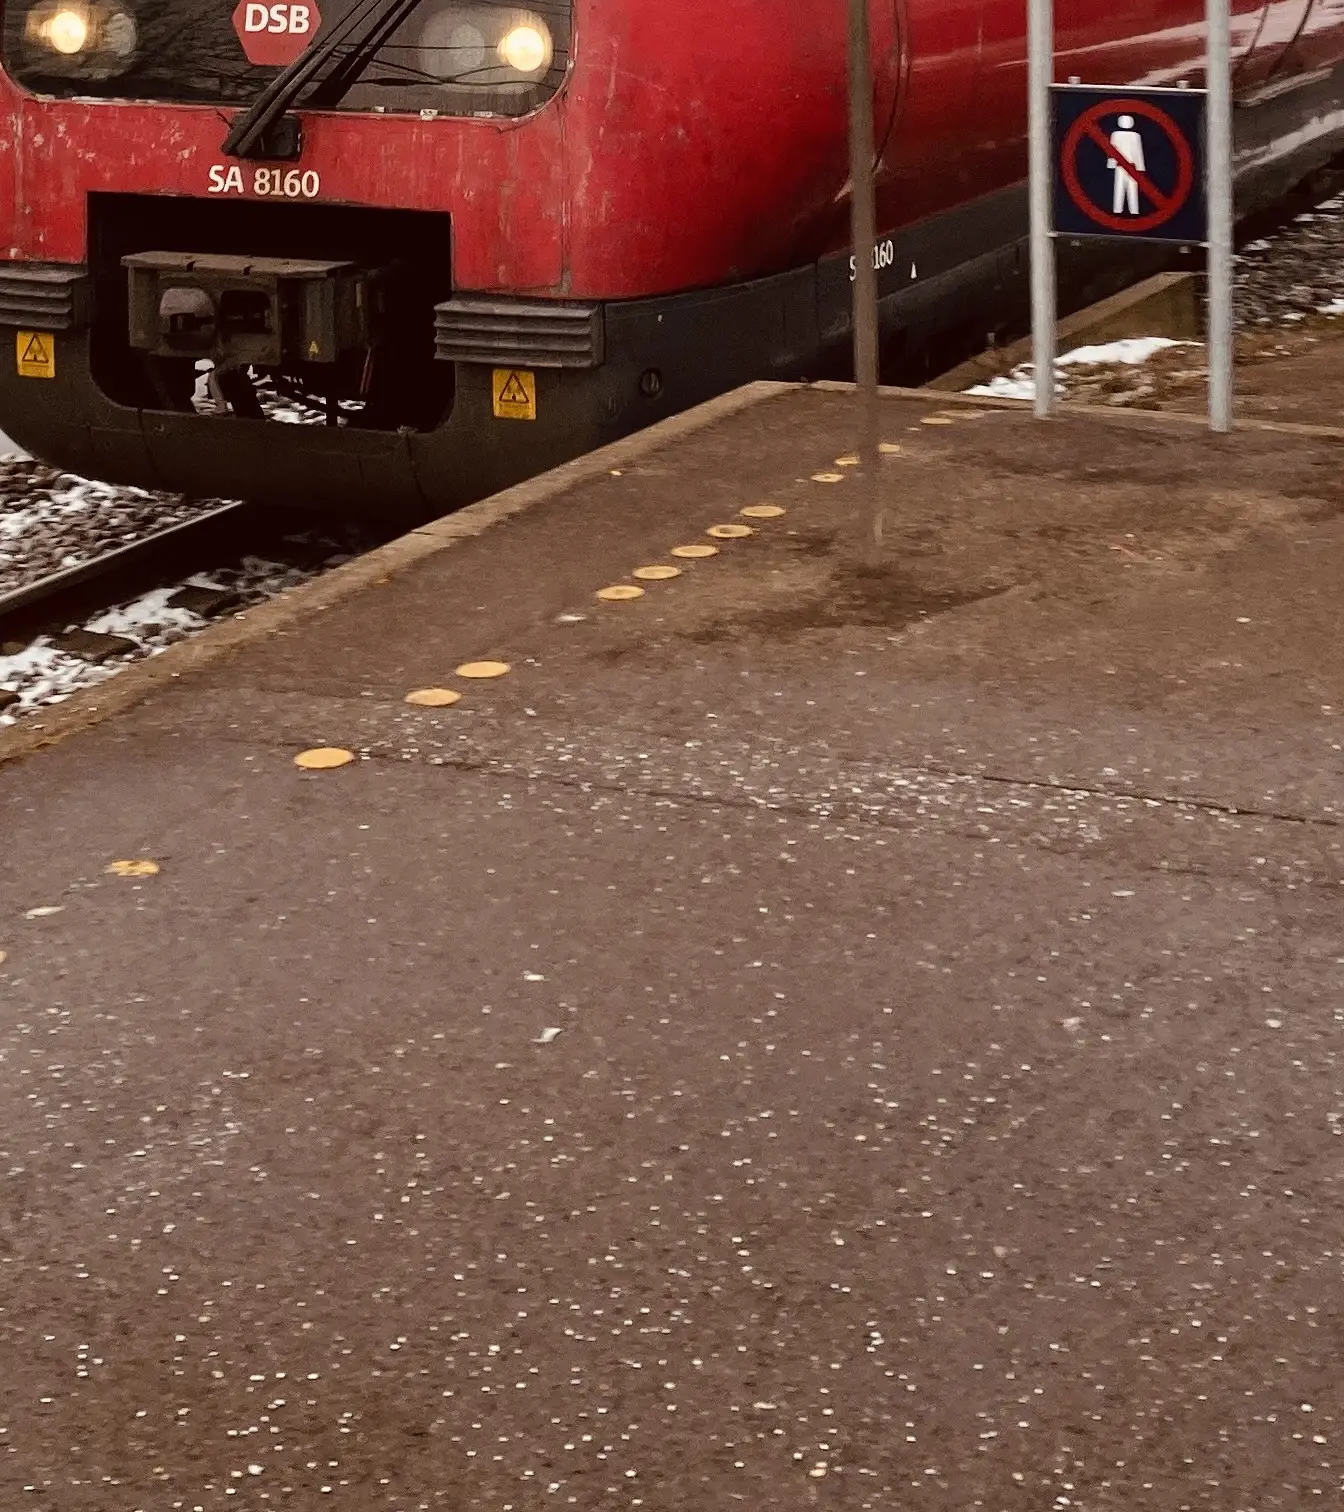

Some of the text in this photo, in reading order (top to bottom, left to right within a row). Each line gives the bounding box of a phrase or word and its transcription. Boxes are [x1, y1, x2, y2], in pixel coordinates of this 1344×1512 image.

[243, 2, 311, 35] DSB
[207, 163, 321, 199] SA 8160
